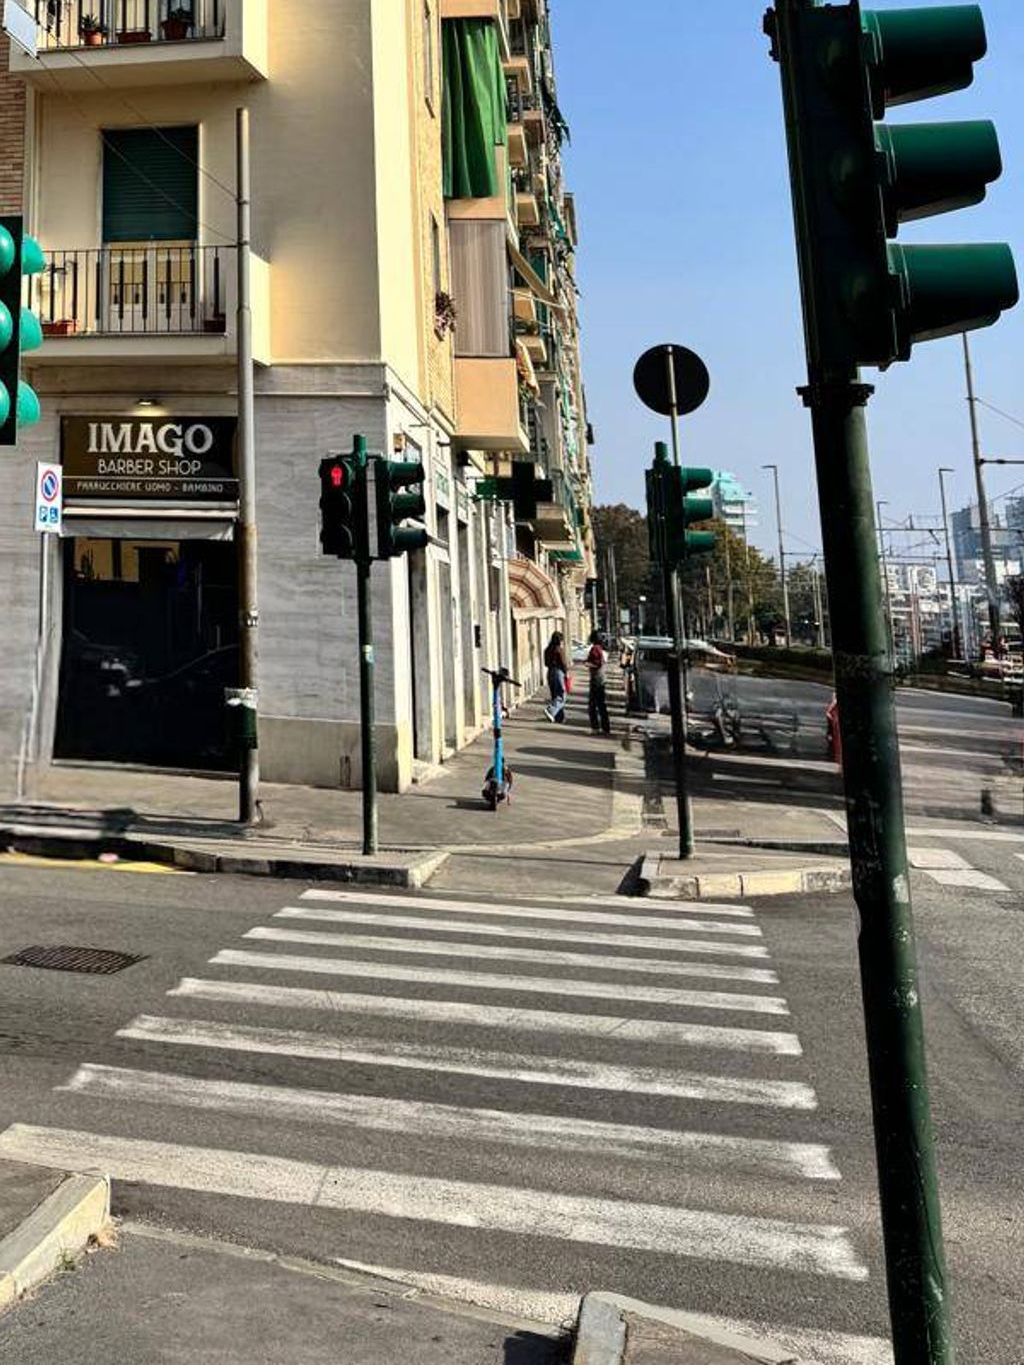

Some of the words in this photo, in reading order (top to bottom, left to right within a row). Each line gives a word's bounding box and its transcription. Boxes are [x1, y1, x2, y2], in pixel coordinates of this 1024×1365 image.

[87, 422, 214, 457] IMAGO
[98, 459, 154, 475] BARBER
[159, 460, 201, 475] SHOP
[145, 483, 171, 493] UOMO
[182, 483, 224, 493] BAMBINO
